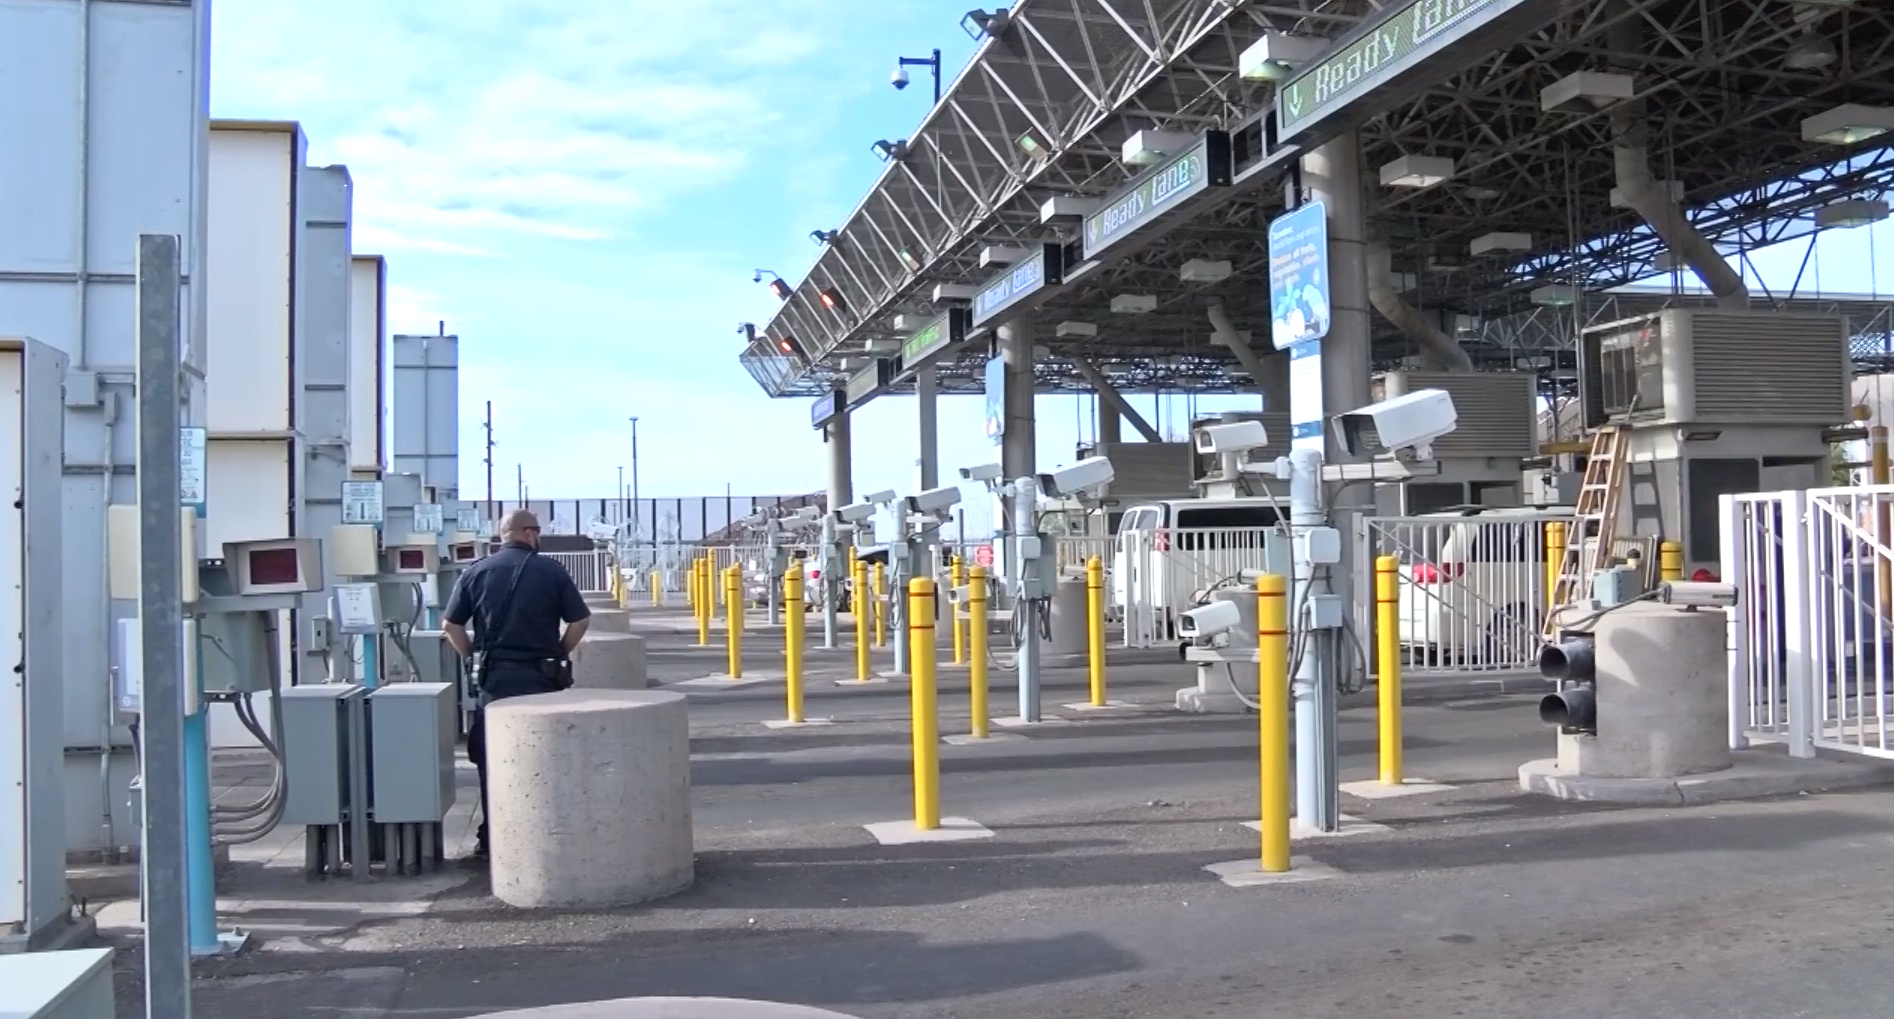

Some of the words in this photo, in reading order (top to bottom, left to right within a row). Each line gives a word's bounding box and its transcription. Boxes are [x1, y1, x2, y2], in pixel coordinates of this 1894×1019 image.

[1315, 26, 1398, 104] Ready
[1412, 0, 1495, 45] Lan
[1103, 191, 1147, 235] Ready
[1151, 160, 1191, 205] Lane
